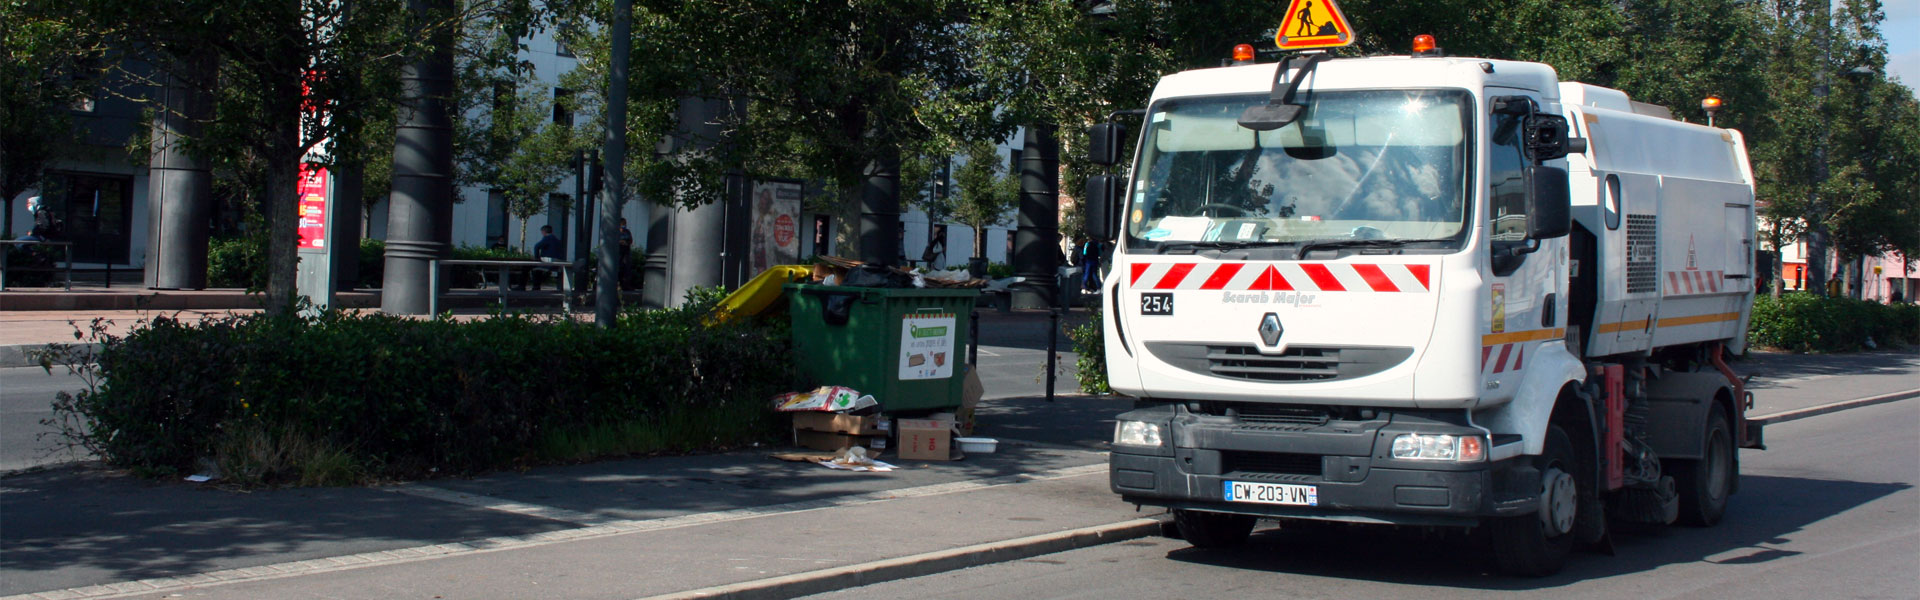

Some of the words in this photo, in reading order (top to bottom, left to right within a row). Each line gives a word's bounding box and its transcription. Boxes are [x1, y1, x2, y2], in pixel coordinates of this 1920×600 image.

[1143, 296, 1171, 312] 254
[1222, 291, 1269, 304] Scarab
[1273, 291, 1316, 308] Major
[1234, 484, 1308, 503] CW-203-VN
